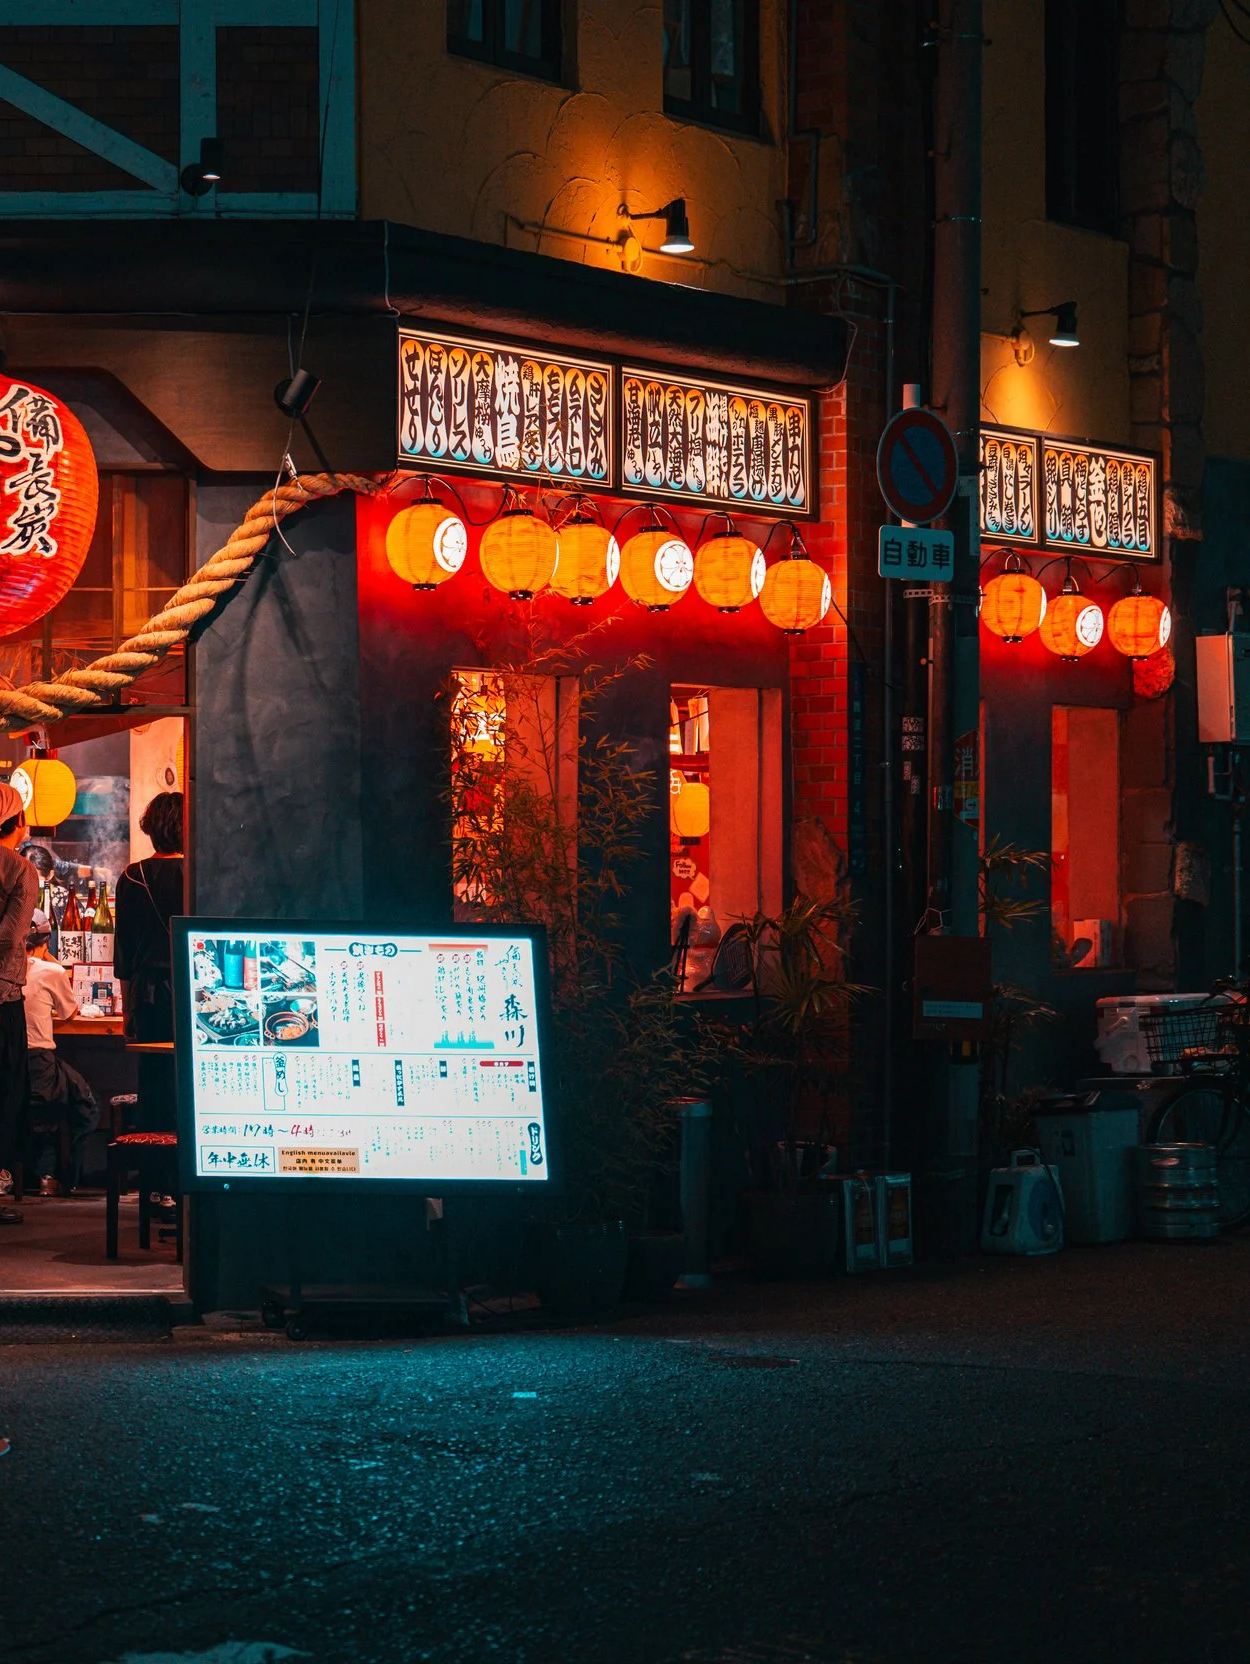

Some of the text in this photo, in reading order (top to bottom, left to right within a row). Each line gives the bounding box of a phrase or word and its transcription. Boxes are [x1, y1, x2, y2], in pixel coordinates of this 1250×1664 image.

[404, 344, 421, 450] せせり
[428, 349, 445, 454] ぼんじり
[451, 353, 468, 457] ソリレス
[495, 355, 521, 470] 焼鳥
[568, 372, 583, 472] ムネトロ
[668, 387, 684, 485] 天然大海老
[787, 410, 801, 500] 串カツ
[1088, 456, 1107, 547] 釜めし
[883, 538, 951, 570] 自動車
[499, 993, 528, 1048] 森川
[275, 1055, 286, 1093] 釜めし
[207, 1151, 271, 1169] 年中無休
[530, 1126, 542, 1162] ドリンク
